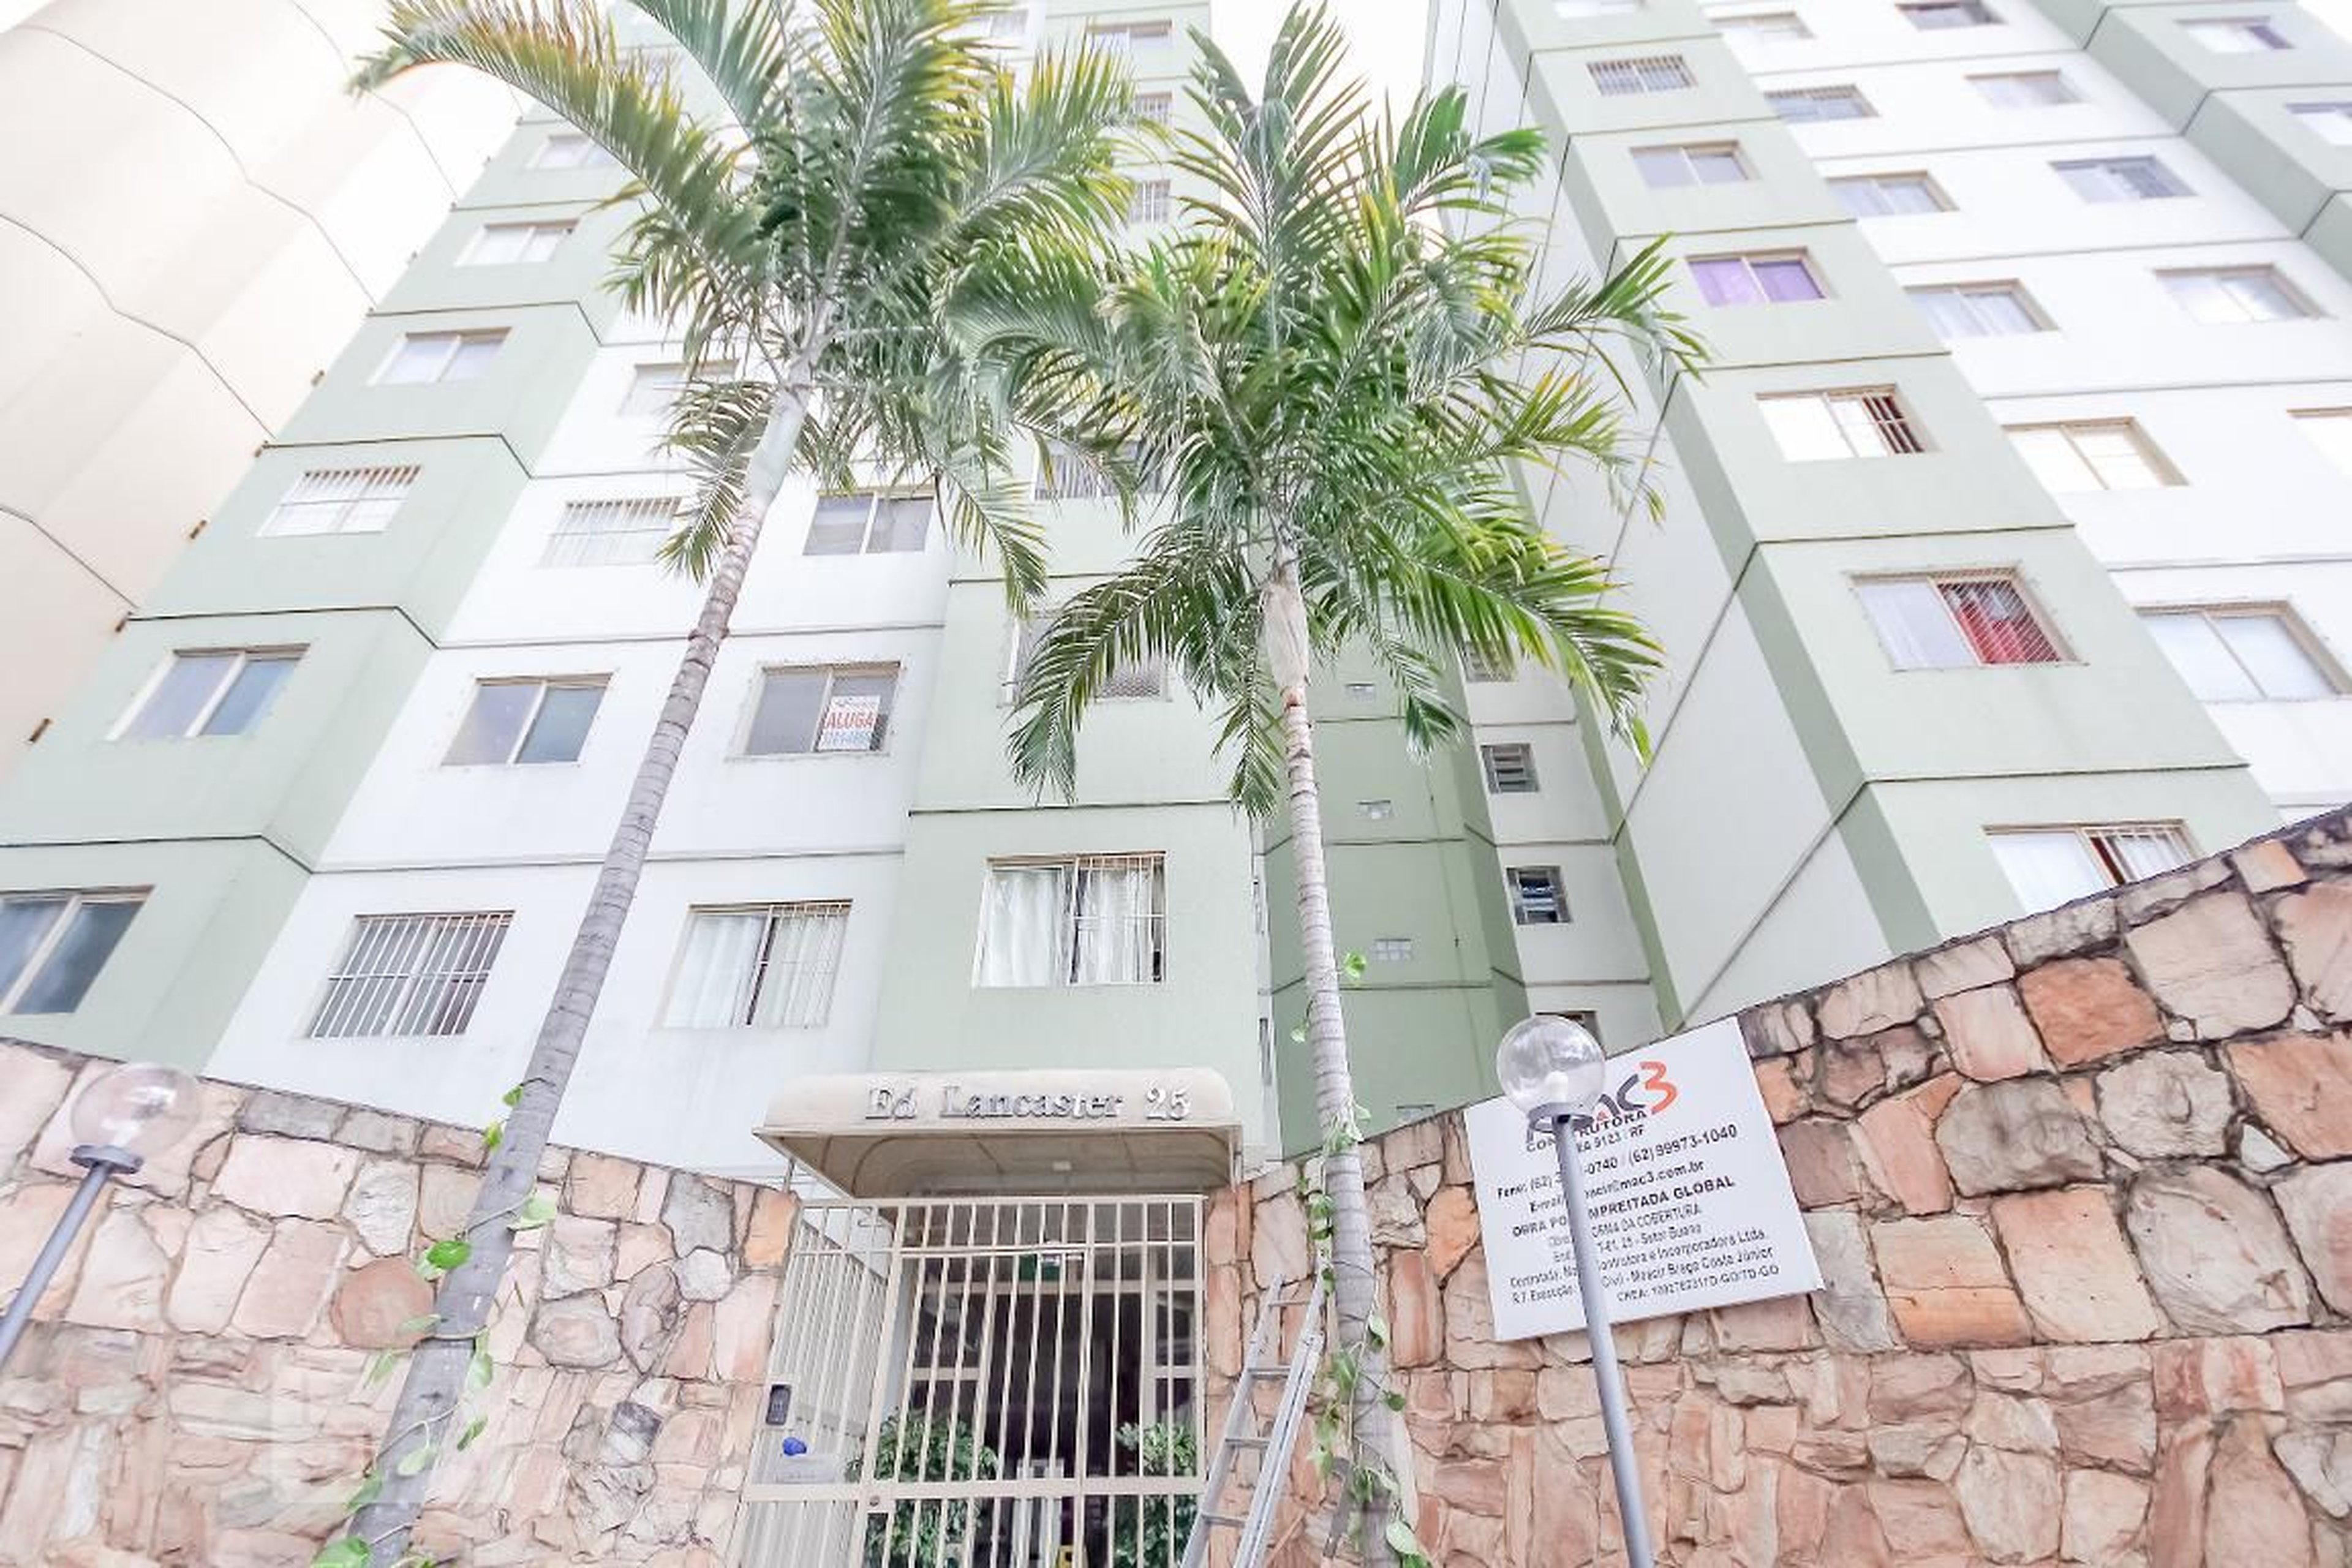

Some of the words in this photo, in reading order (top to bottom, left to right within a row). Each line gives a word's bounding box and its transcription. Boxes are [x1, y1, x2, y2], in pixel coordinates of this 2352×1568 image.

[865, 1084, 916, 1120] Ed
[939, 1084, 1123, 1120] Lancaster
[1144, 1085, 1192, 1122] 25
[1628, 1148, 1655, 1166] (62)
[1673, 1175, 1735, 1199] GLOBAL
